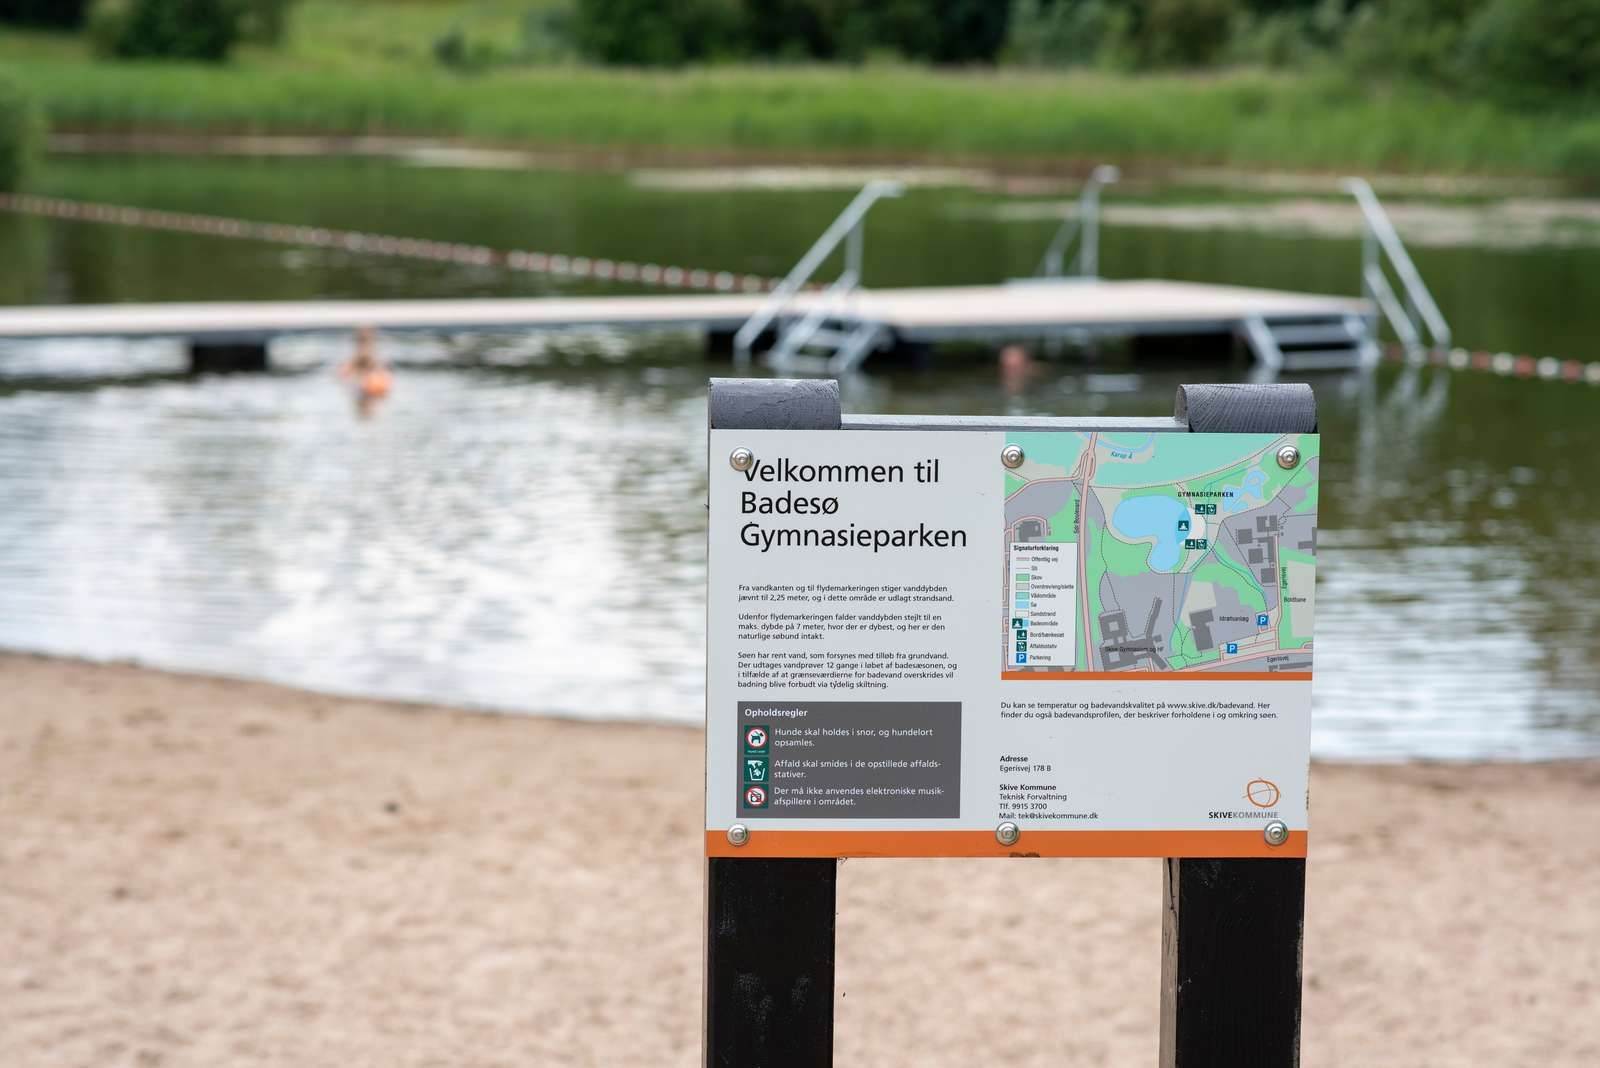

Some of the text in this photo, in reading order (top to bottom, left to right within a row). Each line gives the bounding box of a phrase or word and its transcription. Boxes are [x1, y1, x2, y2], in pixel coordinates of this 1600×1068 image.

[1110, 451, 1126, 460] Karup
[742, 457, 939, 483] Velkommen til
[741, 490, 839, 515] Badesø
[740, 523, 967, 553] Gymnasieparken
[816, 584, 880, 593] flydemarkeringen
[881, 585, 902, 593] stiger
[903, 585, 948, 593] vanddybden
[738, 594, 759, 602] jævnt
[887, 594, 912, 603] udlagt
[770, 614, 834, 622] flydemarkeringen
[858, 614, 903, 622] vanddybden
[904, 614, 922, 622] stejlt
[760, 623, 784, 631] dybde
[785, 623, 795, 631] på
[868, 624, 895, 632] dybest,
[738, 632, 771, 641] naturlige
[826, 652, 857, 660] forsynes
[908, 652, 949, 660] grundvand.
[752, 661, 782, 670] udtages
[783, 662, 824, 670] vandprøver
[737, 681, 768, 689] badning
[856, 681, 888, 689] skiltning.
[1156, 702, 1166, 710] på
[744, 708, 808, 718] Opholdsregler
[1035, 711, 1052, 720] også
[1054, 711, 1122, 719] badevandsprofilen,
[1227, 712, 1258, 720] omkring
[774, 738, 815, 748] opsamles.
[867, 760, 908, 768] opstillede
[999, 765, 1031, 773] Egerisvej
[791, 786, 804, 795] må
[774, 797, 812, 807] afspillere
[818, 798, 856, 806] området.
[1026, 793, 1067, 802] Forvaltning
